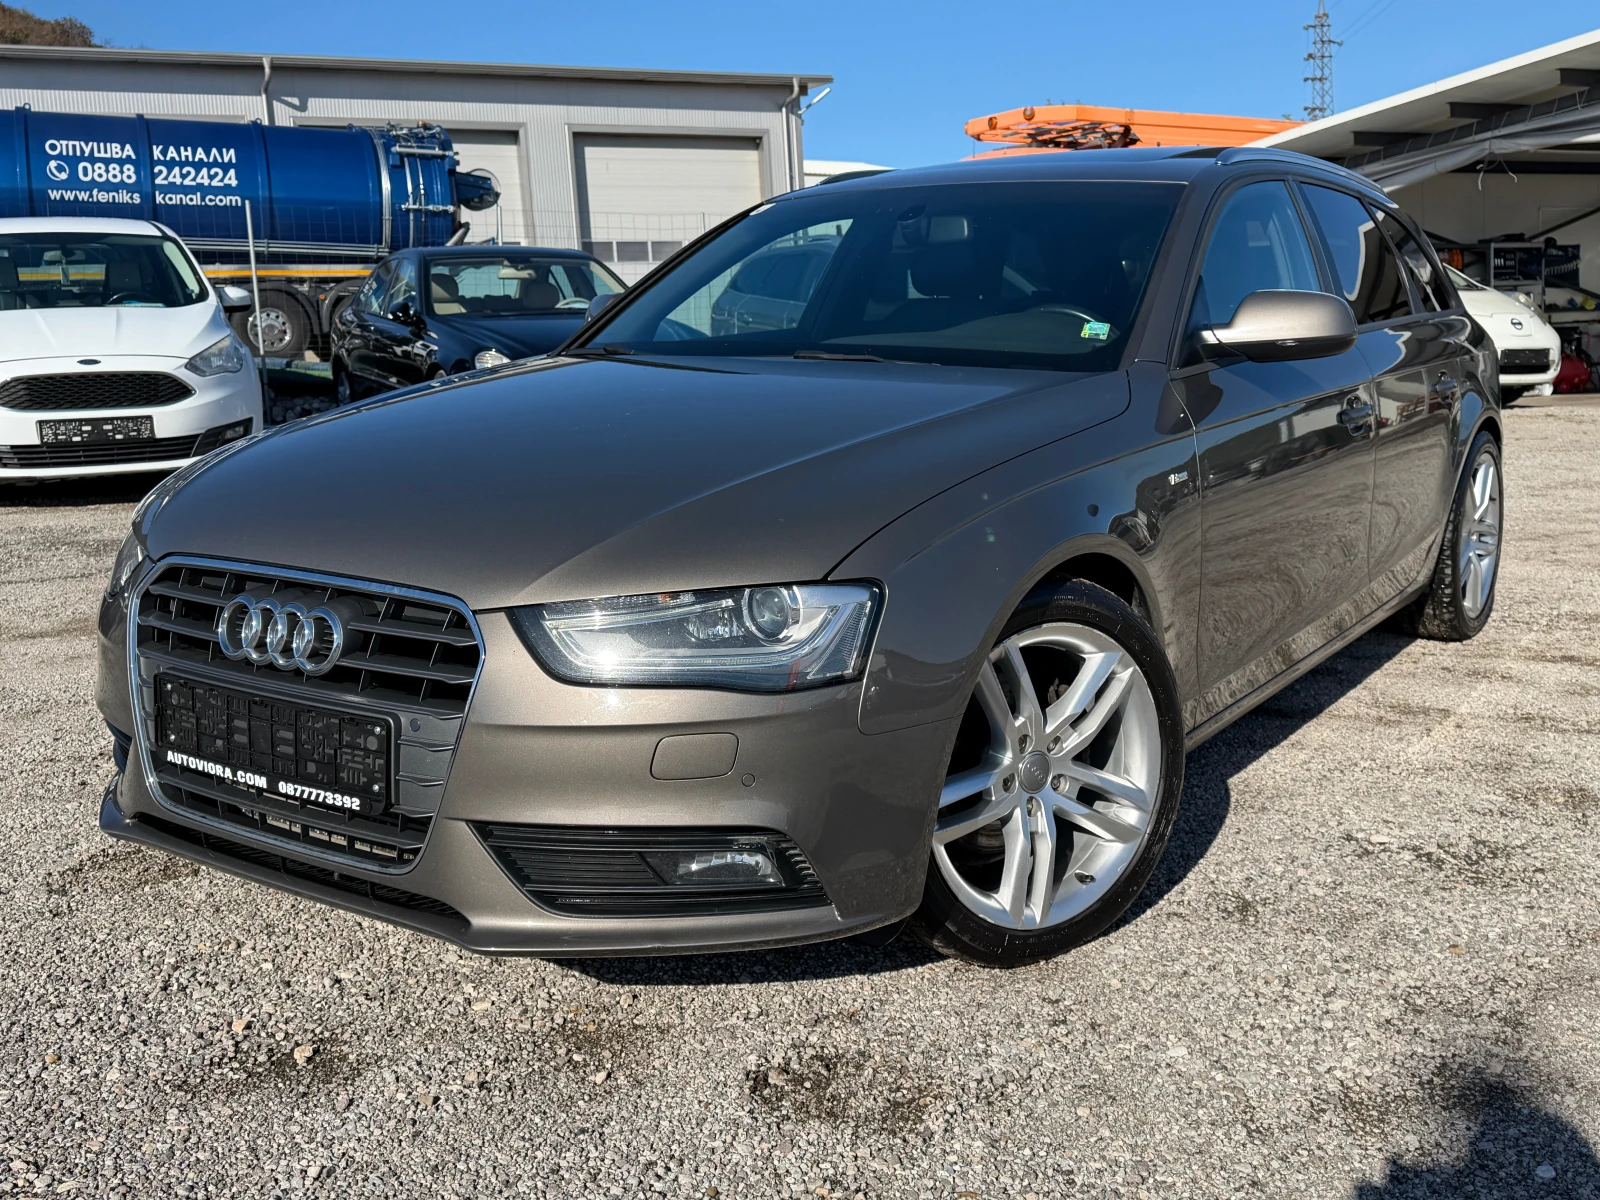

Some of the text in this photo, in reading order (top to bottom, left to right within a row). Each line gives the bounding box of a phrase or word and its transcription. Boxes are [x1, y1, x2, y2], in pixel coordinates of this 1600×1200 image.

[45, 139, 236, 163] ОТПУШВА КАНАЛИ
[77, 161, 238, 187] 0888 242424
[47, 187, 242, 207] www.feniks kanal.com
[166, 750, 361, 811] AUTOVIORA.COM 0877773392
